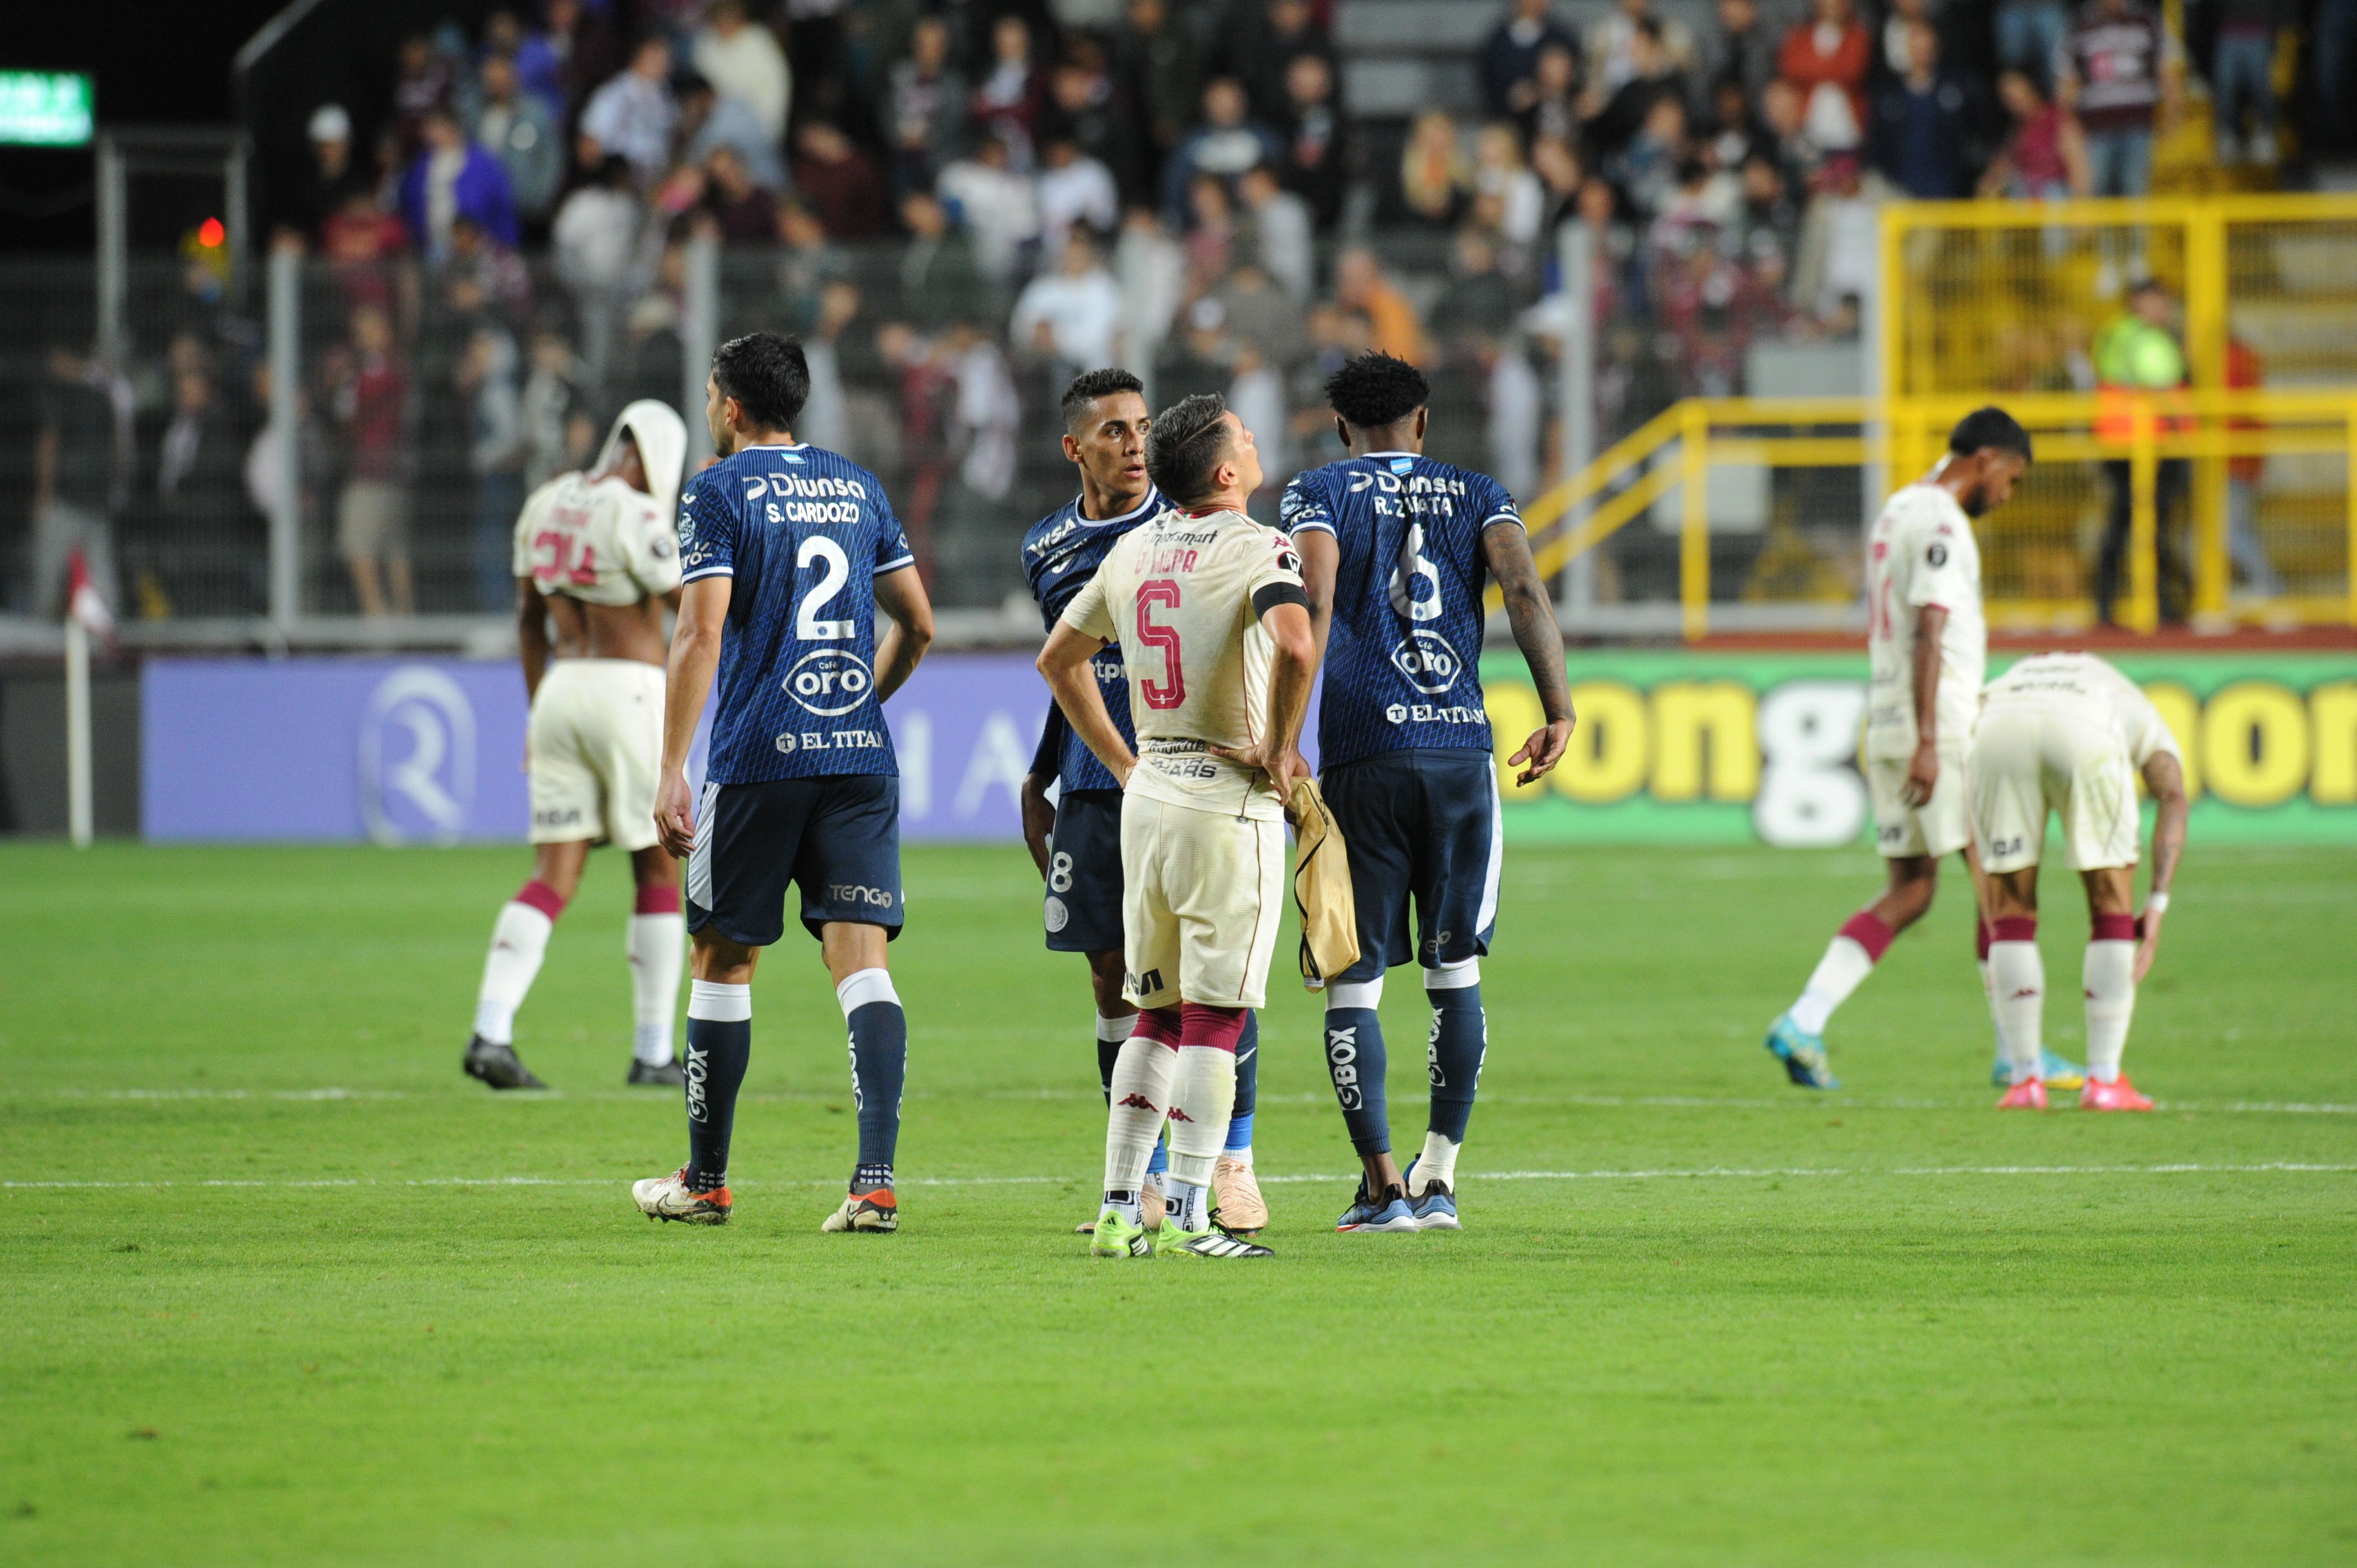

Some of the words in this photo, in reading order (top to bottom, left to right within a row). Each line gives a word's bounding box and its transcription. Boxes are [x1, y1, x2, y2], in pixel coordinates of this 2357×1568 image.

[769, 472, 866, 499] Diunsa
[766, 503, 785, 523] S.
[786, 502, 860, 524] CARDOZO
[1374, 496, 1393, 515] R.
[1026, 518, 1077, 558] VISA
[796, 535, 856, 640] 2
[1388, 523, 1443, 621] 6
[1136, 579, 1186, 710] 5
[795, 669, 866, 695] oro
[1411, 704, 1441, 721] EL
[1438, 706, 1486, 725] TITAN
[801, 732, 830, 750] EL
[832, 730, 884, 749] TITAN
[1165, 765, 1217, 778] ARS
[1050, 851, 1073, 893] 8
[687, 1041, 709, 1123] GBOX
[1329, 1027, 1363, 1111] GBOX
